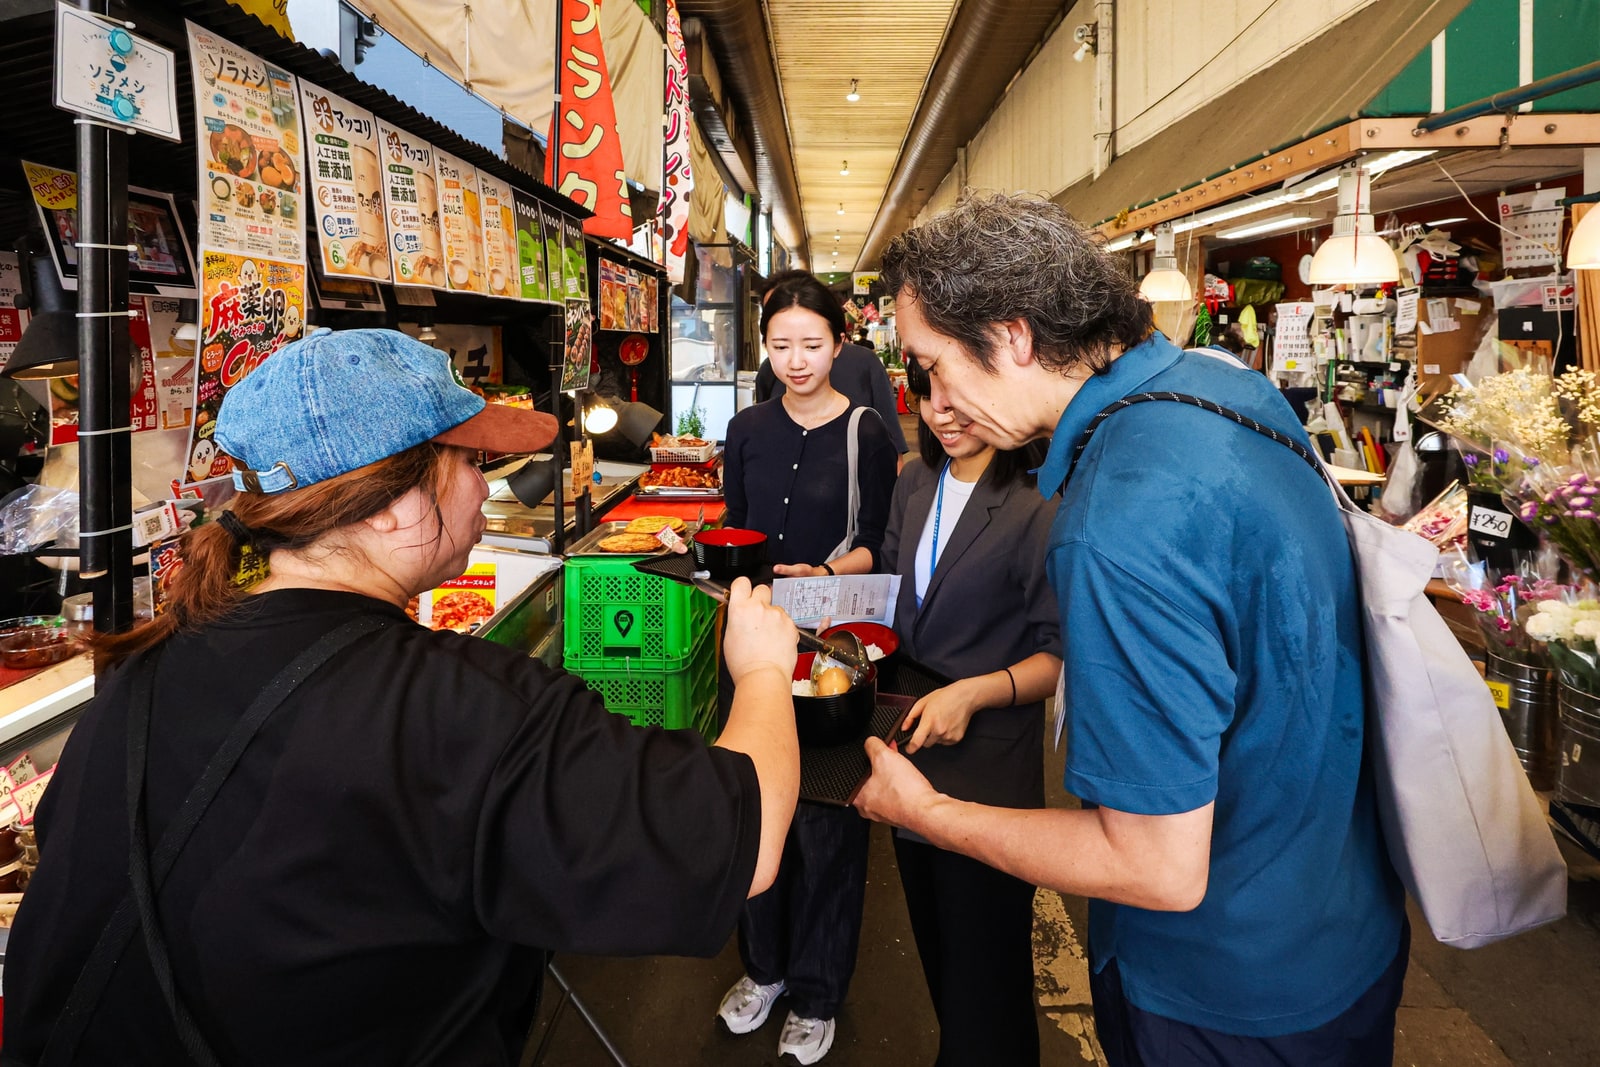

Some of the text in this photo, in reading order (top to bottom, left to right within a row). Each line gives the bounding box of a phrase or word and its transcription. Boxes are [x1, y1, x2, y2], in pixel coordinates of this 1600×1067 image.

[89, 64, 145, 94] ソラメシ
[207, 53, 265, 88] ソラメシ
[317, 147, 350, 162] 人工甘味料
[318, 159, 353, 181] 無添加
[391, 186, 417, 203] 無添加
[1501, 204, 1510, 215] 8
[206, 281, 285, 341] 麻薬卵
[1472, 513, 1508, 532] ¥250
